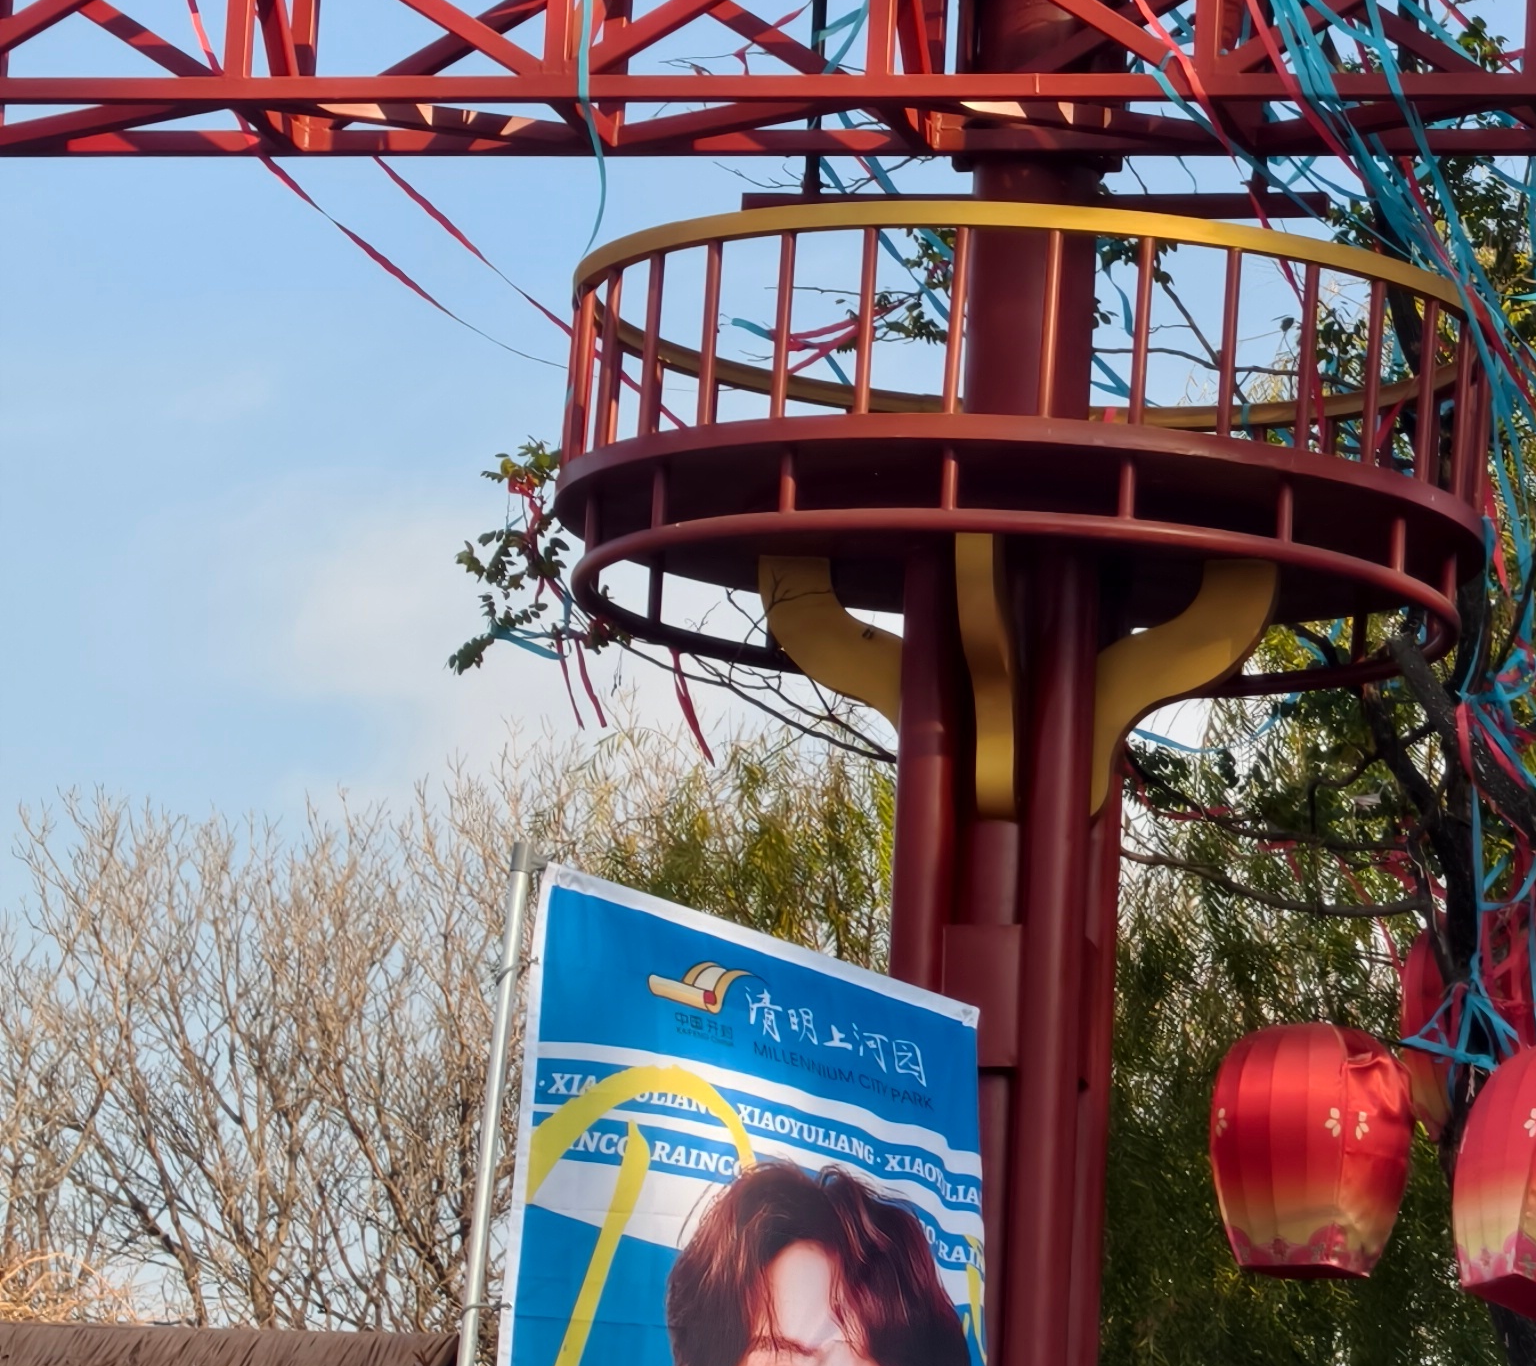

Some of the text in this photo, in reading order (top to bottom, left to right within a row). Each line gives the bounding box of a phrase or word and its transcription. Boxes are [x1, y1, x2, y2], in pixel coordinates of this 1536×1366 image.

[745, 986, 927, 1087] 清明上河园
[754, 1041, 855, 1085] MILLENNIUM
[891, 1088, 935, 1112] PARK
[737, 1103, 874, 1165] XIAOYULIANG
